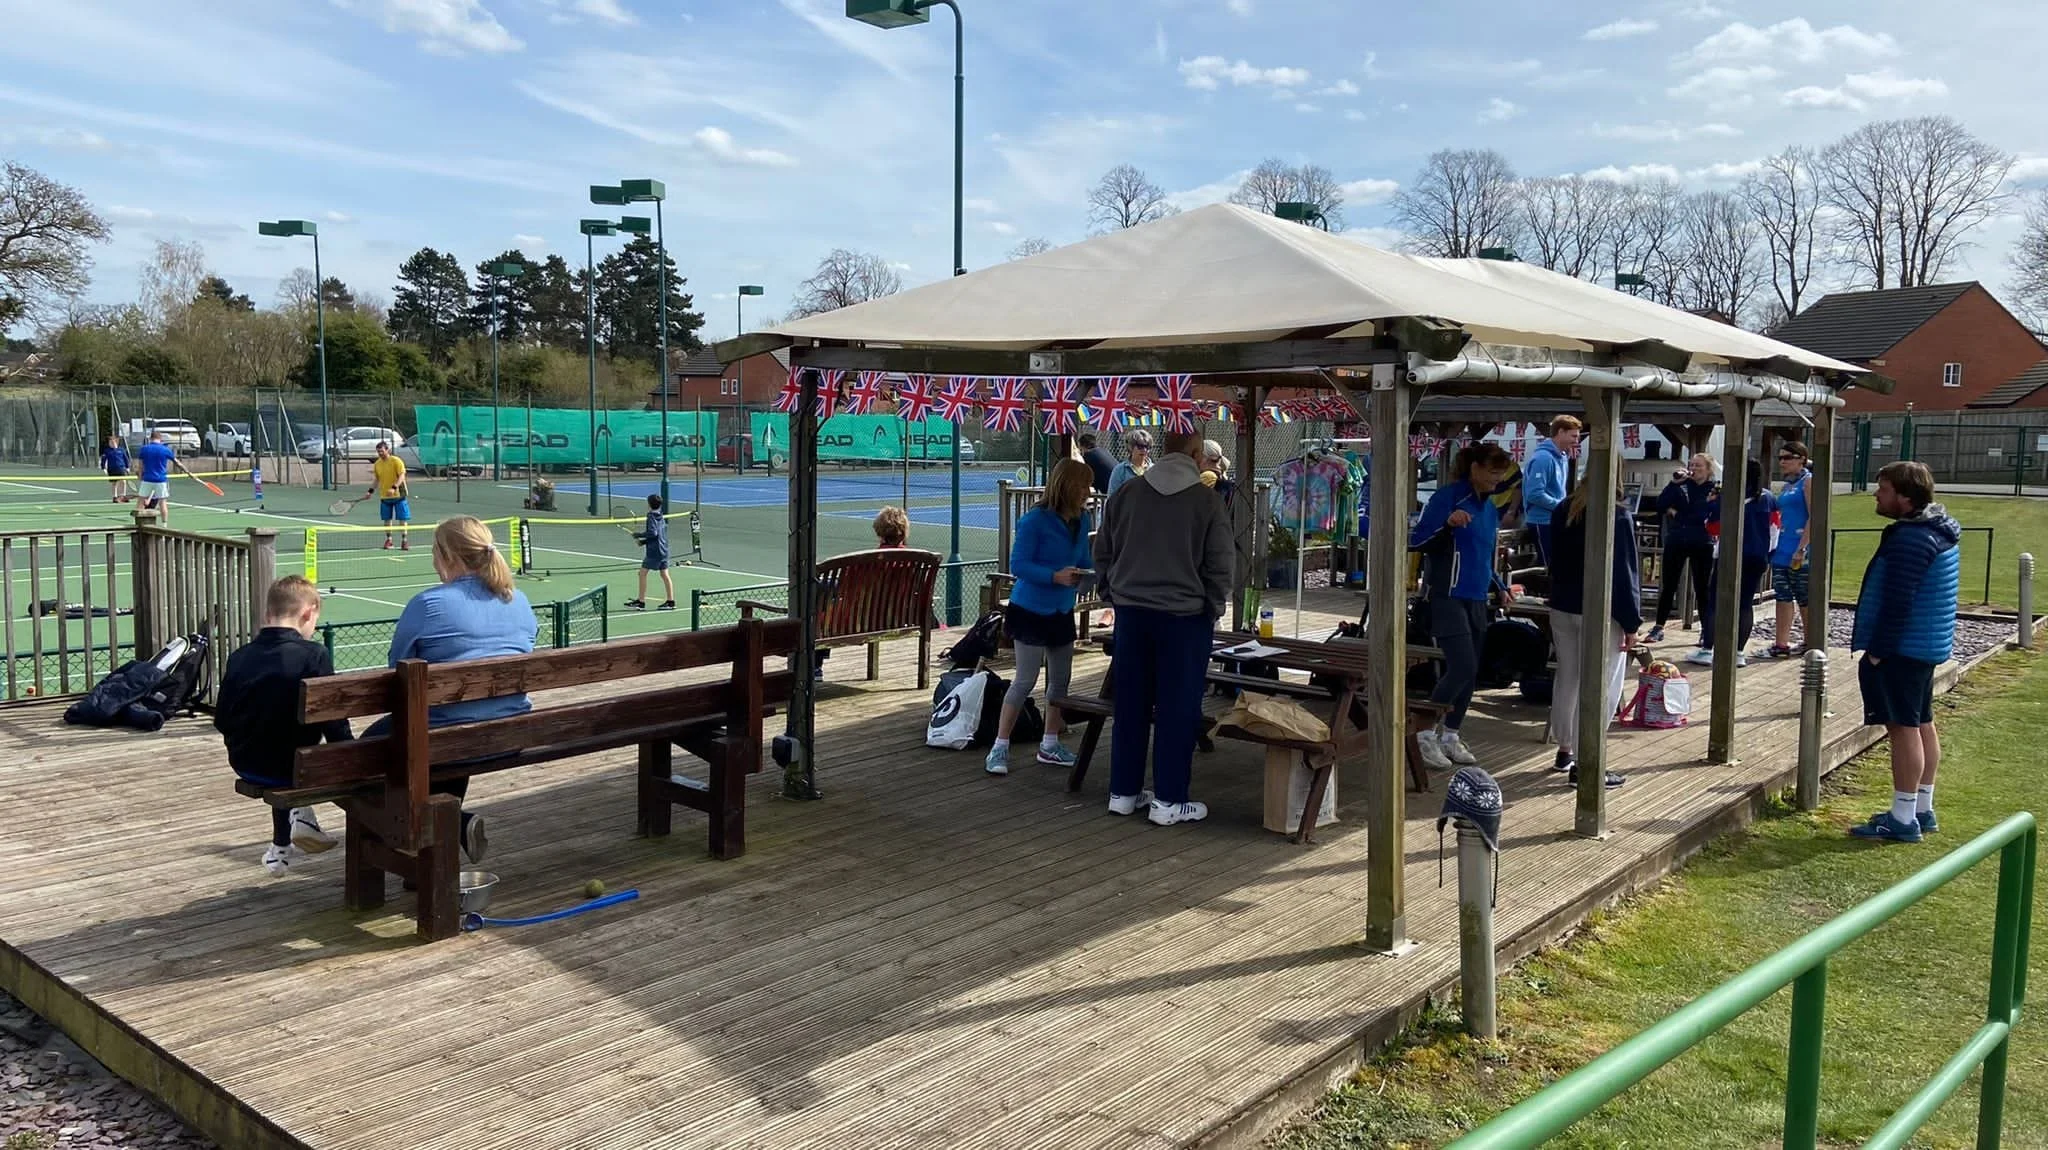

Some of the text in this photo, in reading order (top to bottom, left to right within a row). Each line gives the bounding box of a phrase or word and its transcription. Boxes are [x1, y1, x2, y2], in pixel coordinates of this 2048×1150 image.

[476, 433, 569, 448] HEAD
[631, 434, 706, 448] HEAD
[899, 434, 952, 446] HEAD
